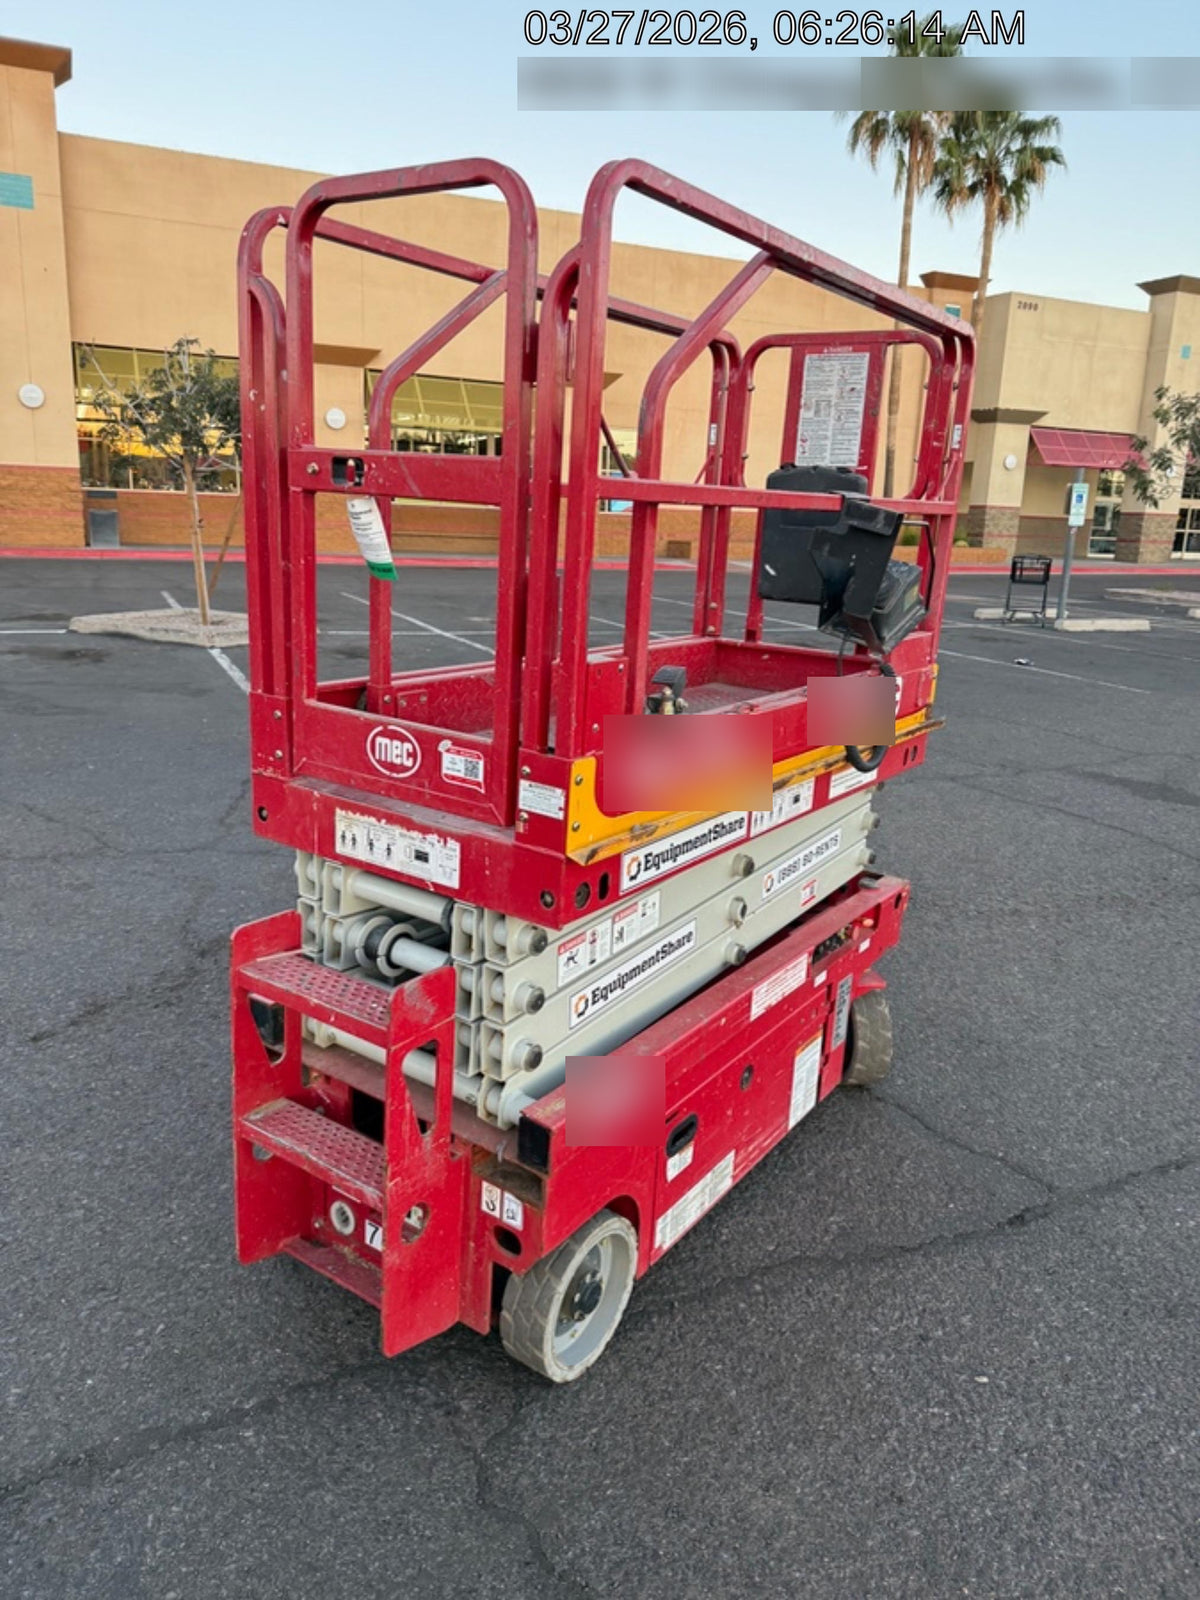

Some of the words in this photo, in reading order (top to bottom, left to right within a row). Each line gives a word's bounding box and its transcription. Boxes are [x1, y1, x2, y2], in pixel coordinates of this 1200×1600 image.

[643, 817, 745, 873] EquipmentShare
[591, 931, 693, 1006] EquipmentShare
[367, 1222, 380, 1245] 7
